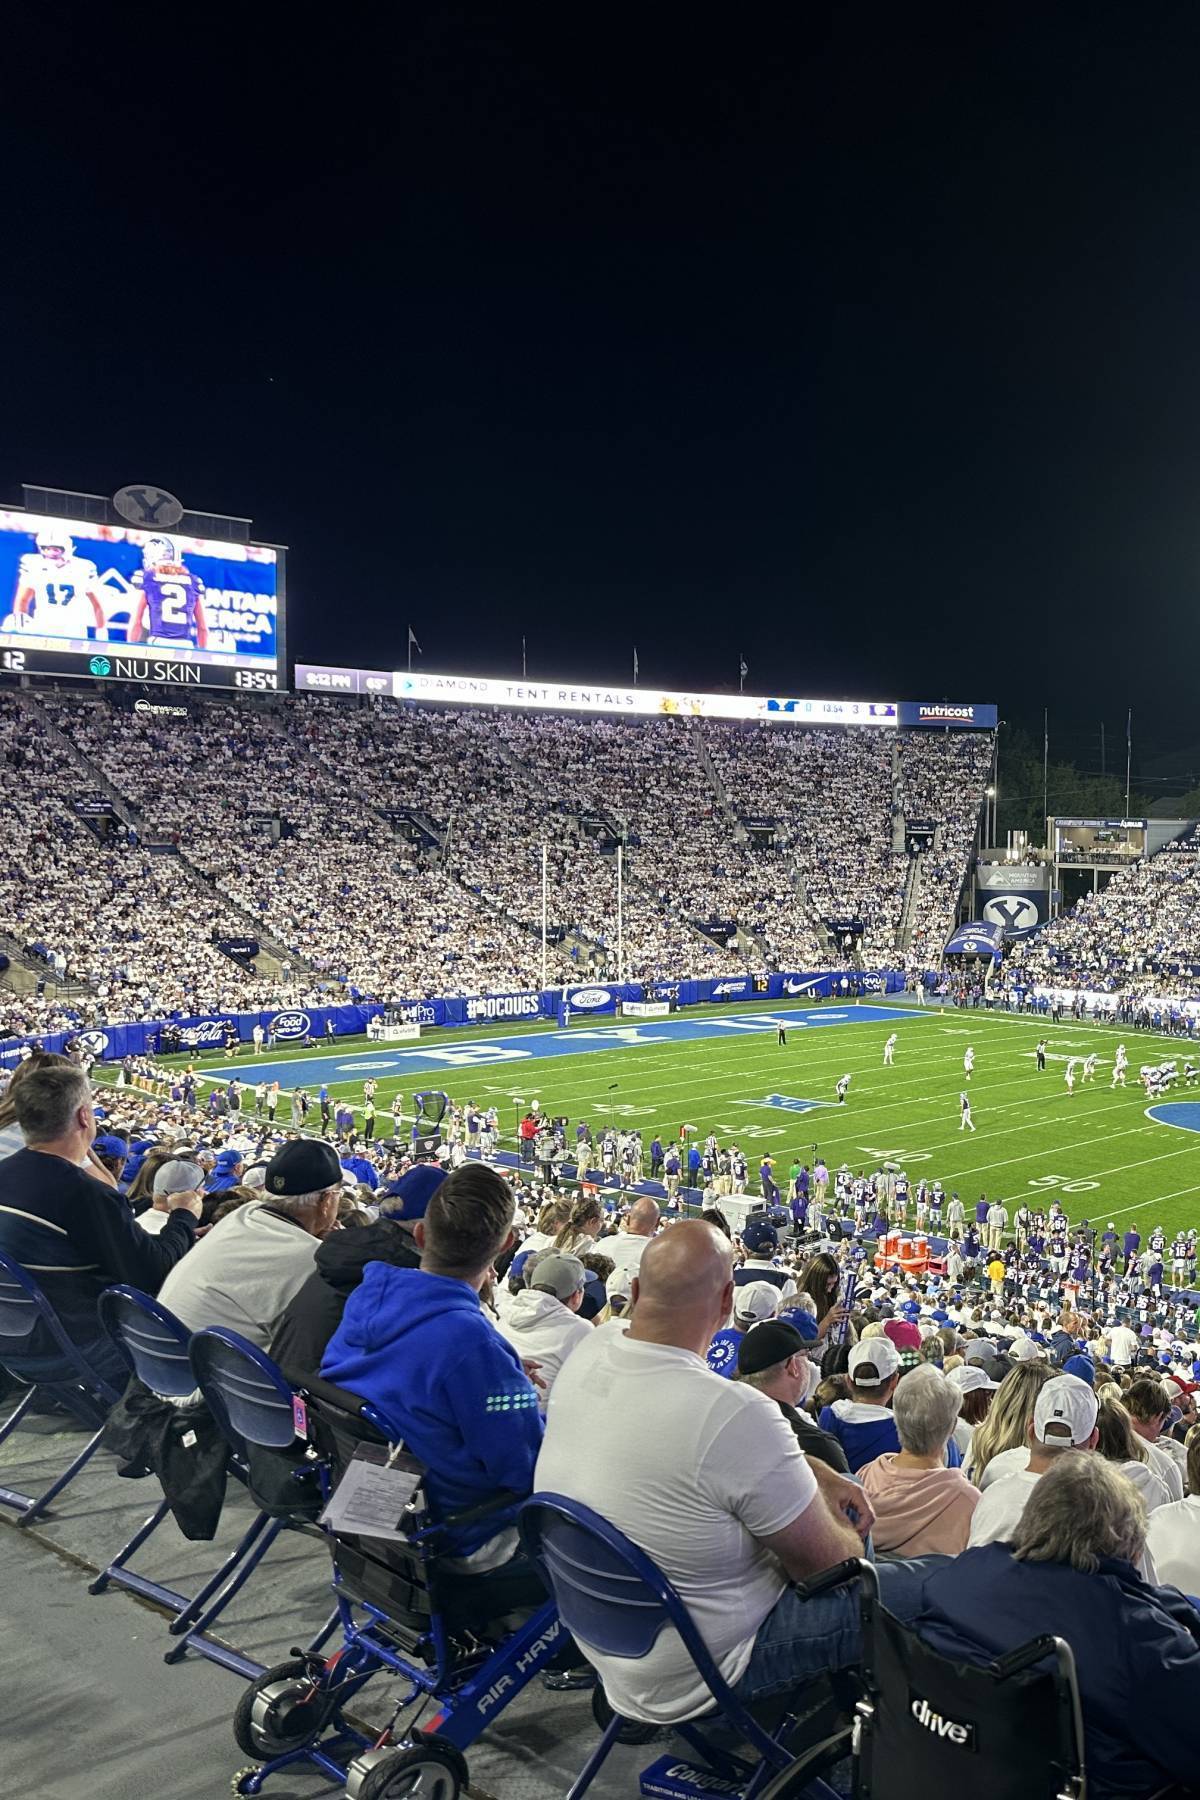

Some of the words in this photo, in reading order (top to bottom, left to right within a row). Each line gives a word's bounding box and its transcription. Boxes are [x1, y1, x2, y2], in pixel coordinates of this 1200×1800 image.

[46, 583, 75, 606] 17
[160, 584, 187, 624] 2
[3, 651, 25, 670] 12
[115, 659, 149, 679] NU
[153, 663, 201, 683] SKIN
[235, 671, 277, 689] 13:54
[332, 674, 351, 688] PM
[420, 678, 488, 691] DIAMOND
[507, 687, 549, 700] TENT
[558, 691, 634, 705] RENTALS
[920, 705, 974, 717] nutricost
[1028, 1174, 1101, 1193] 50
[933, 1194, 940, 1203] 5
[1152, 1240, 1164, 1250] 60
[1175, 1246, 1185, 1257] 16
[477, 1675, 515, 1715] AIR
[515, 1620, 560, 1673] HAW
[911, 1700, 968, 1744] drive
